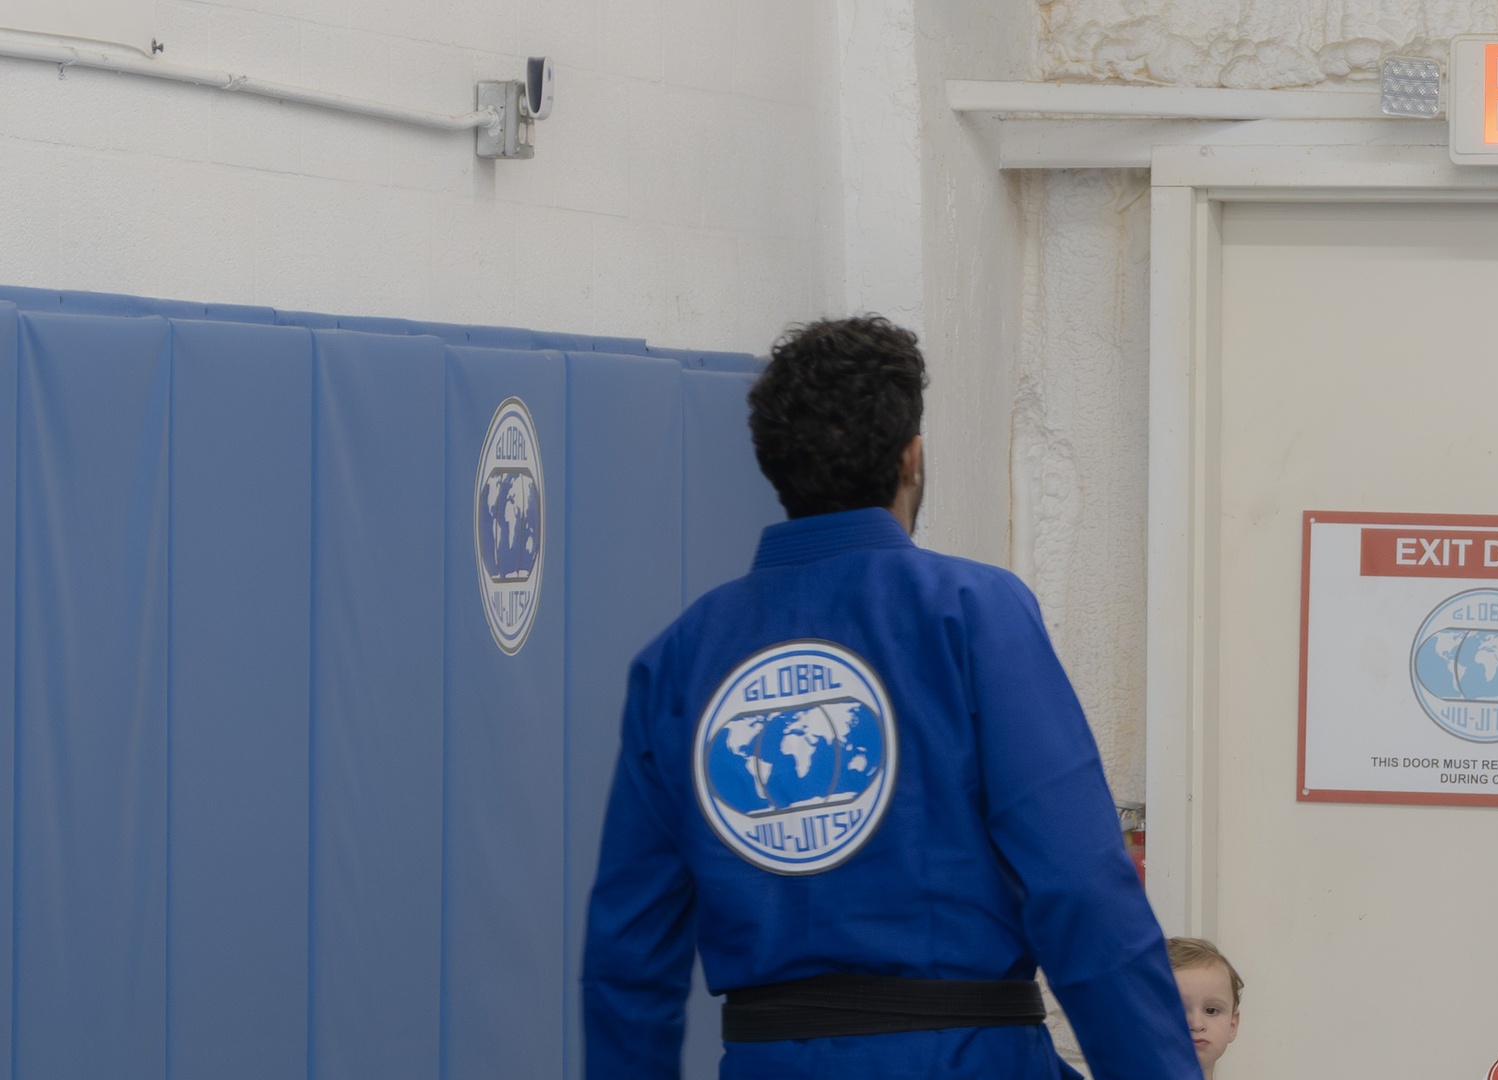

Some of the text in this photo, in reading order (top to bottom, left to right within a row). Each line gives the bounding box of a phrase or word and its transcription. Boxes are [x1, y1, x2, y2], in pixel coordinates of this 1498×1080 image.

[495, 425, 528, 461] GLOBAL
[1395, 537, 1473, 567] EXIT
[743, 663, 843, 702] GLOBAL
[1370, 756, 1399, 769] THIS
[1402, 757, 1440, 769] DOOR
[1443, 759, 1479, 770] MUST
[1440, 773, 1489, 785] DURING
[744, 808, 864, 853] JIU-JITSU
